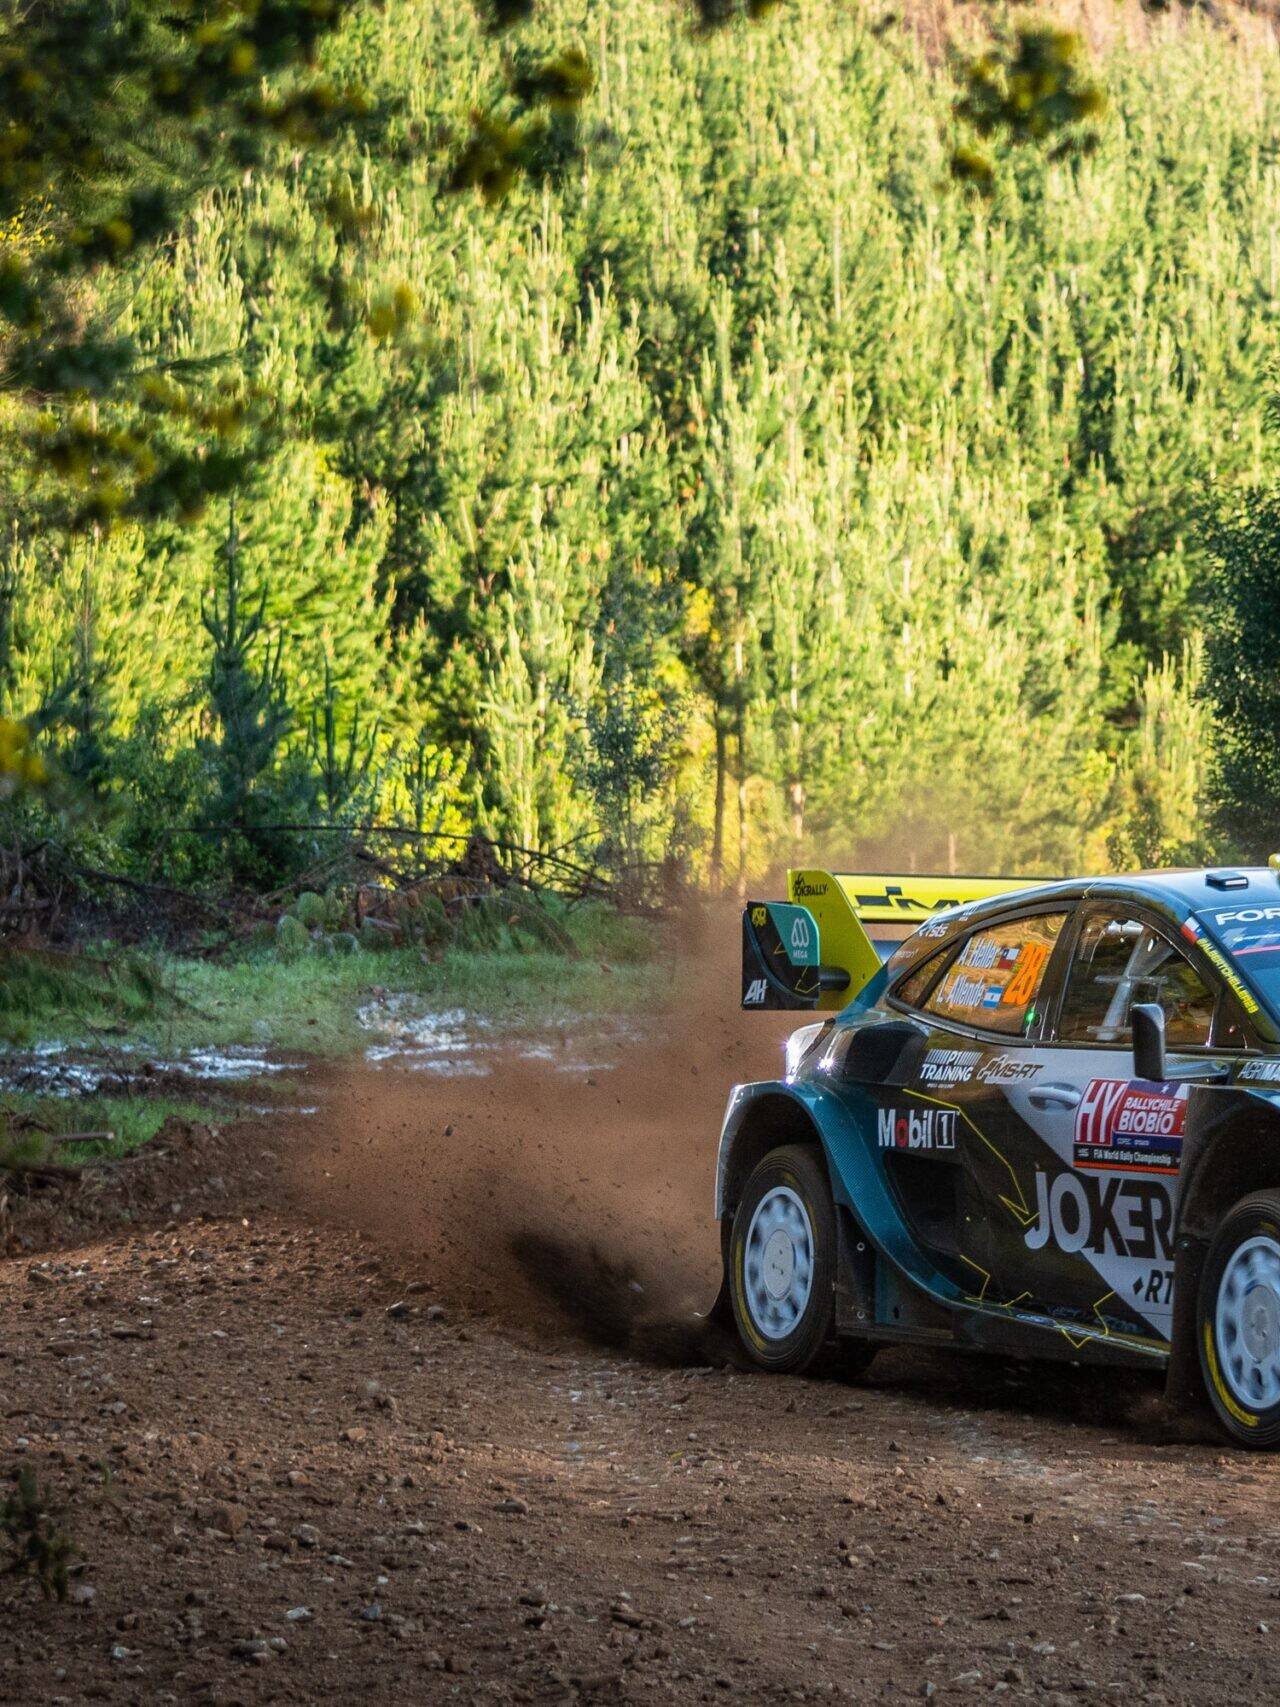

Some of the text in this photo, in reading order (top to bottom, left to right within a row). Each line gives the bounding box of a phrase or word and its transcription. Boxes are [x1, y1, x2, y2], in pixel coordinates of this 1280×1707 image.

[1002, 940, 1048, 1006] 28
[920, 1063, 974, 1082] TRAINING
[877, 1108, 933, 1149] Mobil
[1075, 1081, 1129, 1143] HY
[1024, 1171, 1177, 1262] JOKER
